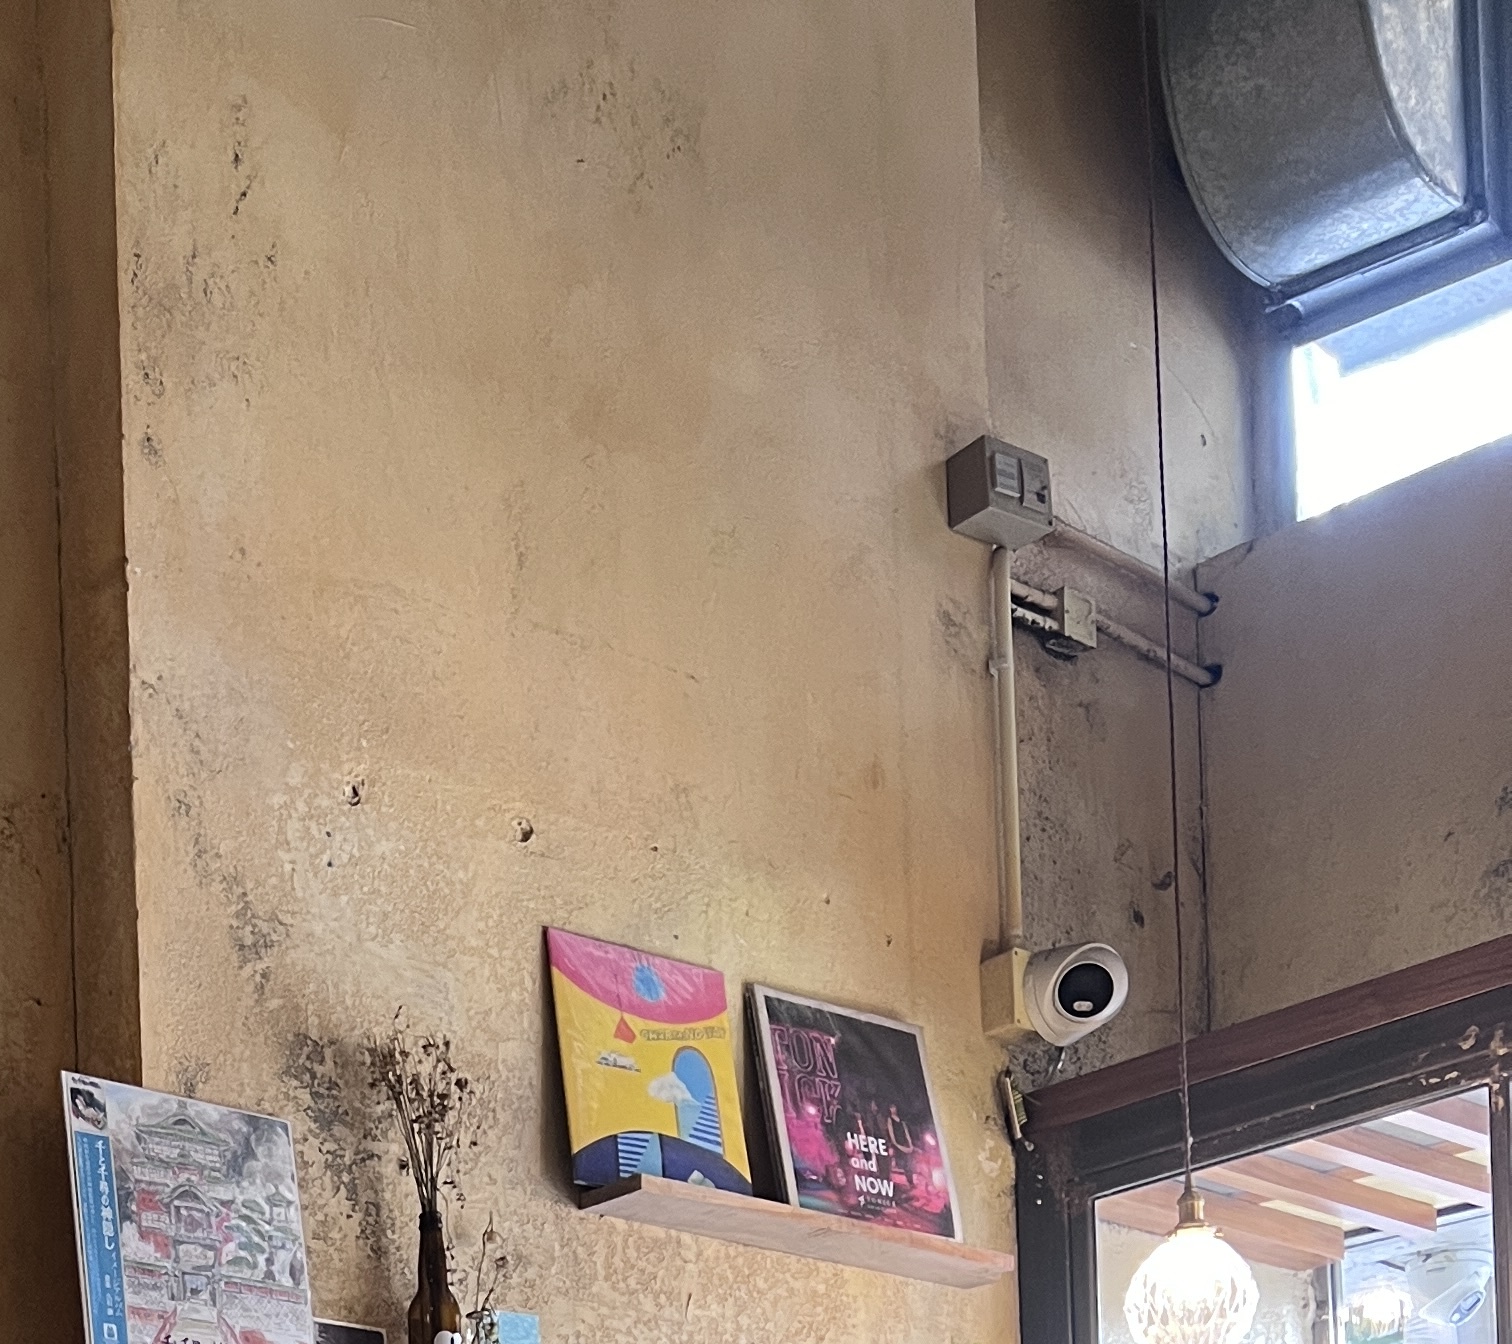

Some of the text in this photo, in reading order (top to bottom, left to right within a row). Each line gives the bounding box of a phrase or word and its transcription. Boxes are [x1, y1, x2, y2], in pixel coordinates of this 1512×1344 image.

[846, 1131, 888, 1156] HERE
[850, 1157, 878, 1172] and
[854, 1174, 894, 1197] NOW
